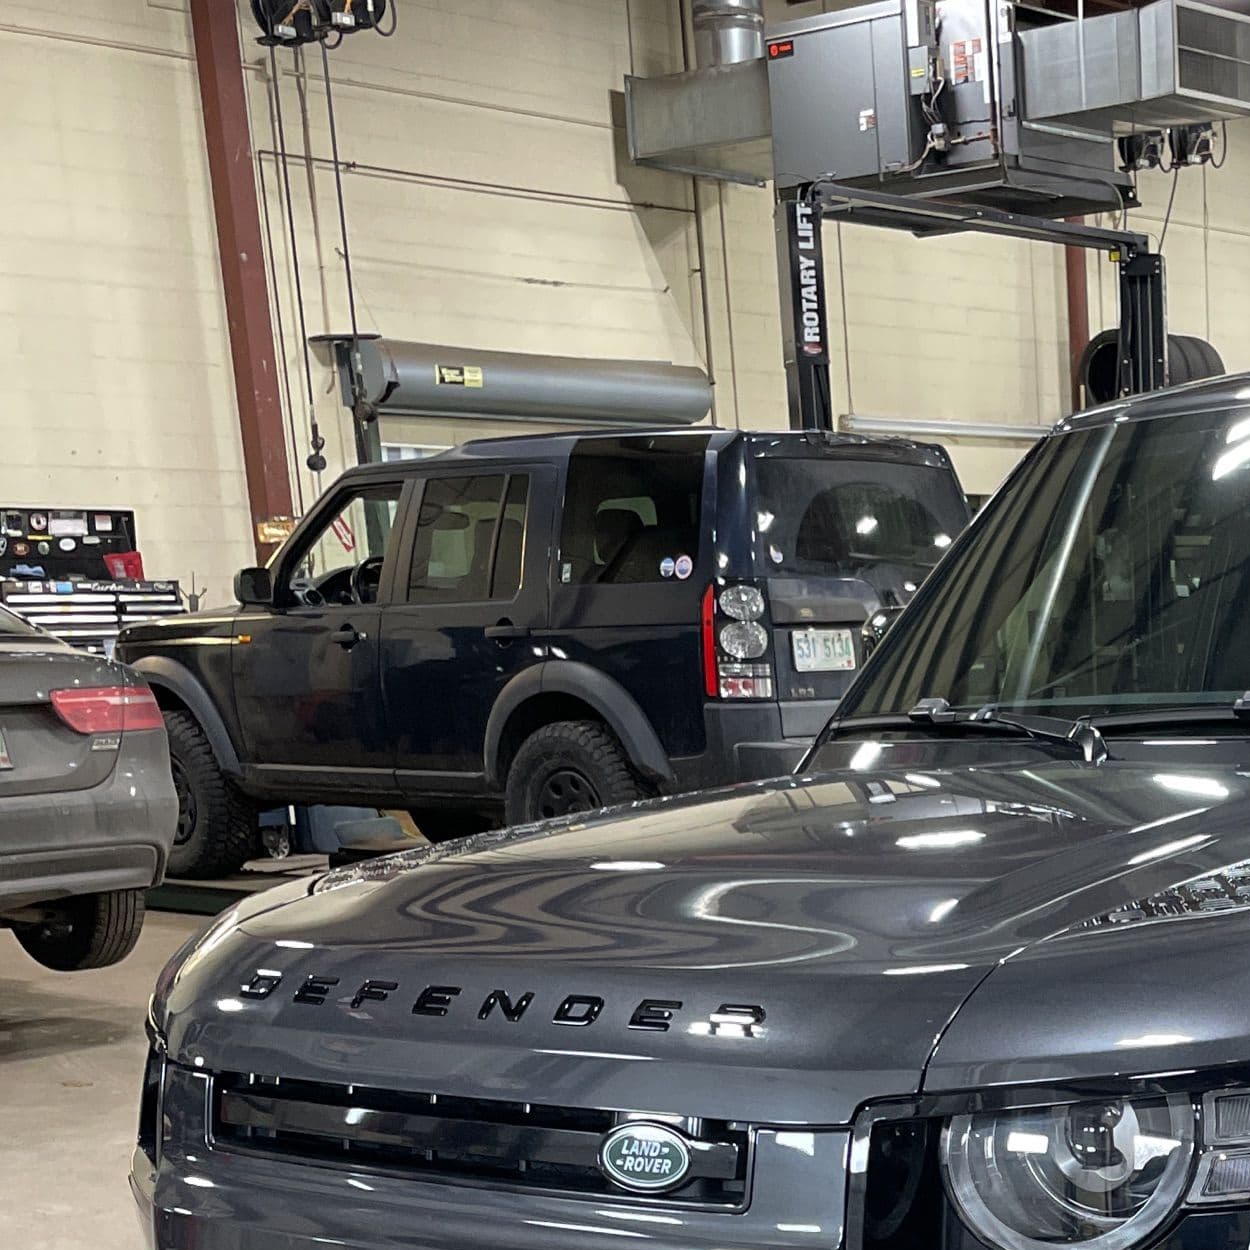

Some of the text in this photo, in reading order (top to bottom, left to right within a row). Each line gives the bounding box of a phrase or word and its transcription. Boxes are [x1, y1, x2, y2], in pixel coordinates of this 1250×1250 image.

[796, 203, 820, 342] ROTARY LIFT
[239, 968, 768, 1038] DEFENDER
[622, 1140, 661, 1157] LAND
[623, 1156, 672, 1174] ROVER
